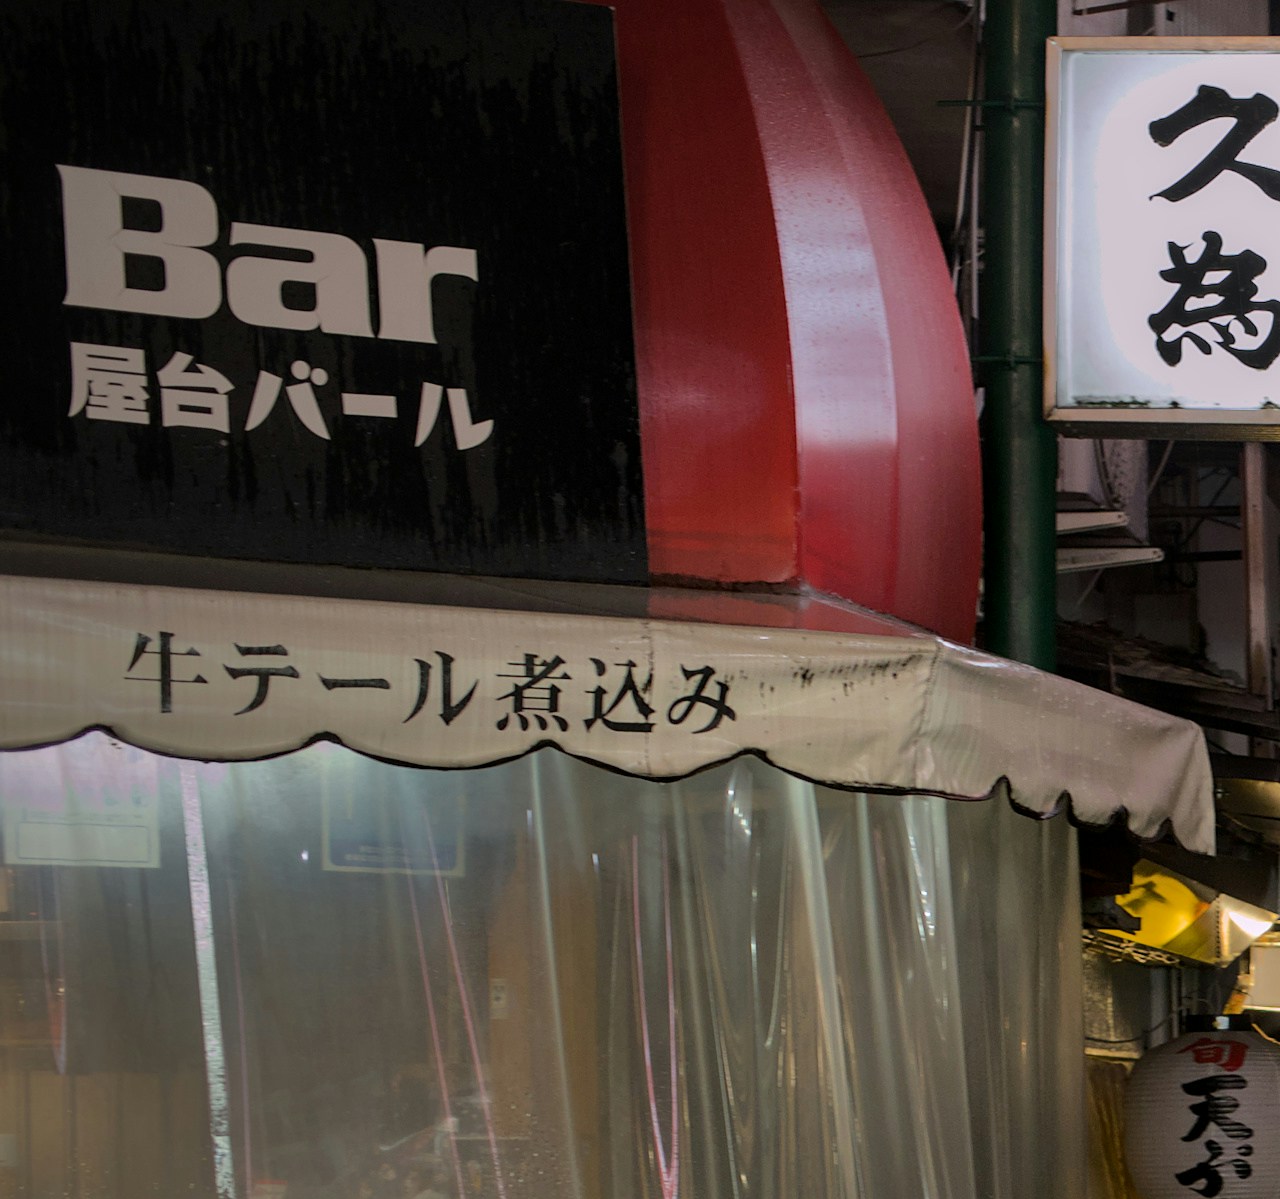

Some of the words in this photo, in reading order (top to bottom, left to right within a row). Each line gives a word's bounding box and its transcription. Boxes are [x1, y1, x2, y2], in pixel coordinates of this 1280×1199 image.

[55, 163, 480, 346] Bar
[67, 341, 496, 452] 屋台バール
[126, 630, 740, 736] 牛テール煮込み
